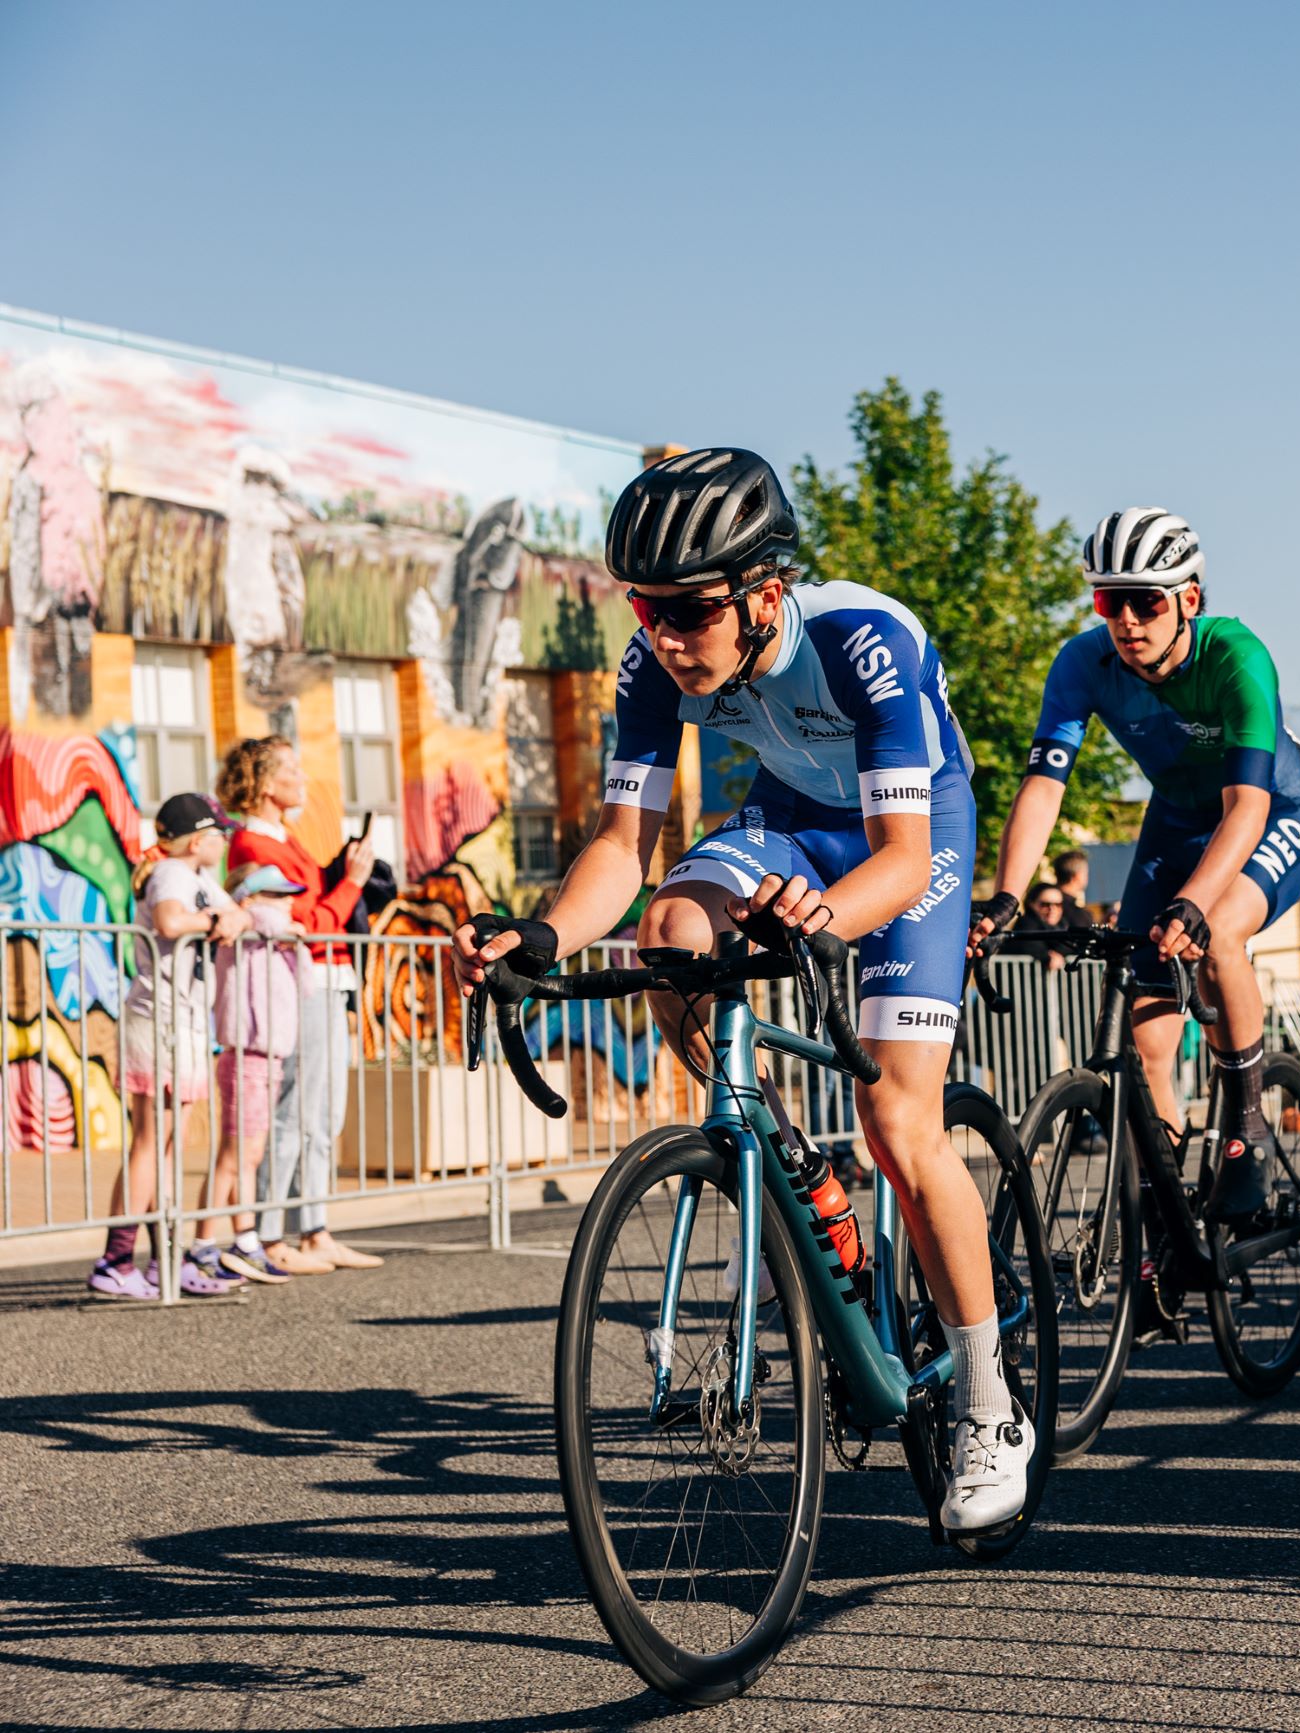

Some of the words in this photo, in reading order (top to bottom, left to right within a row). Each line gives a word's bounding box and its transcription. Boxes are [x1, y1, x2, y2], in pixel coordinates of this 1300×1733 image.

[842, 623, 904, 704] NSW
[1028, 747, 1069, 768] EO
[901, 872, 960, 923] WALES
